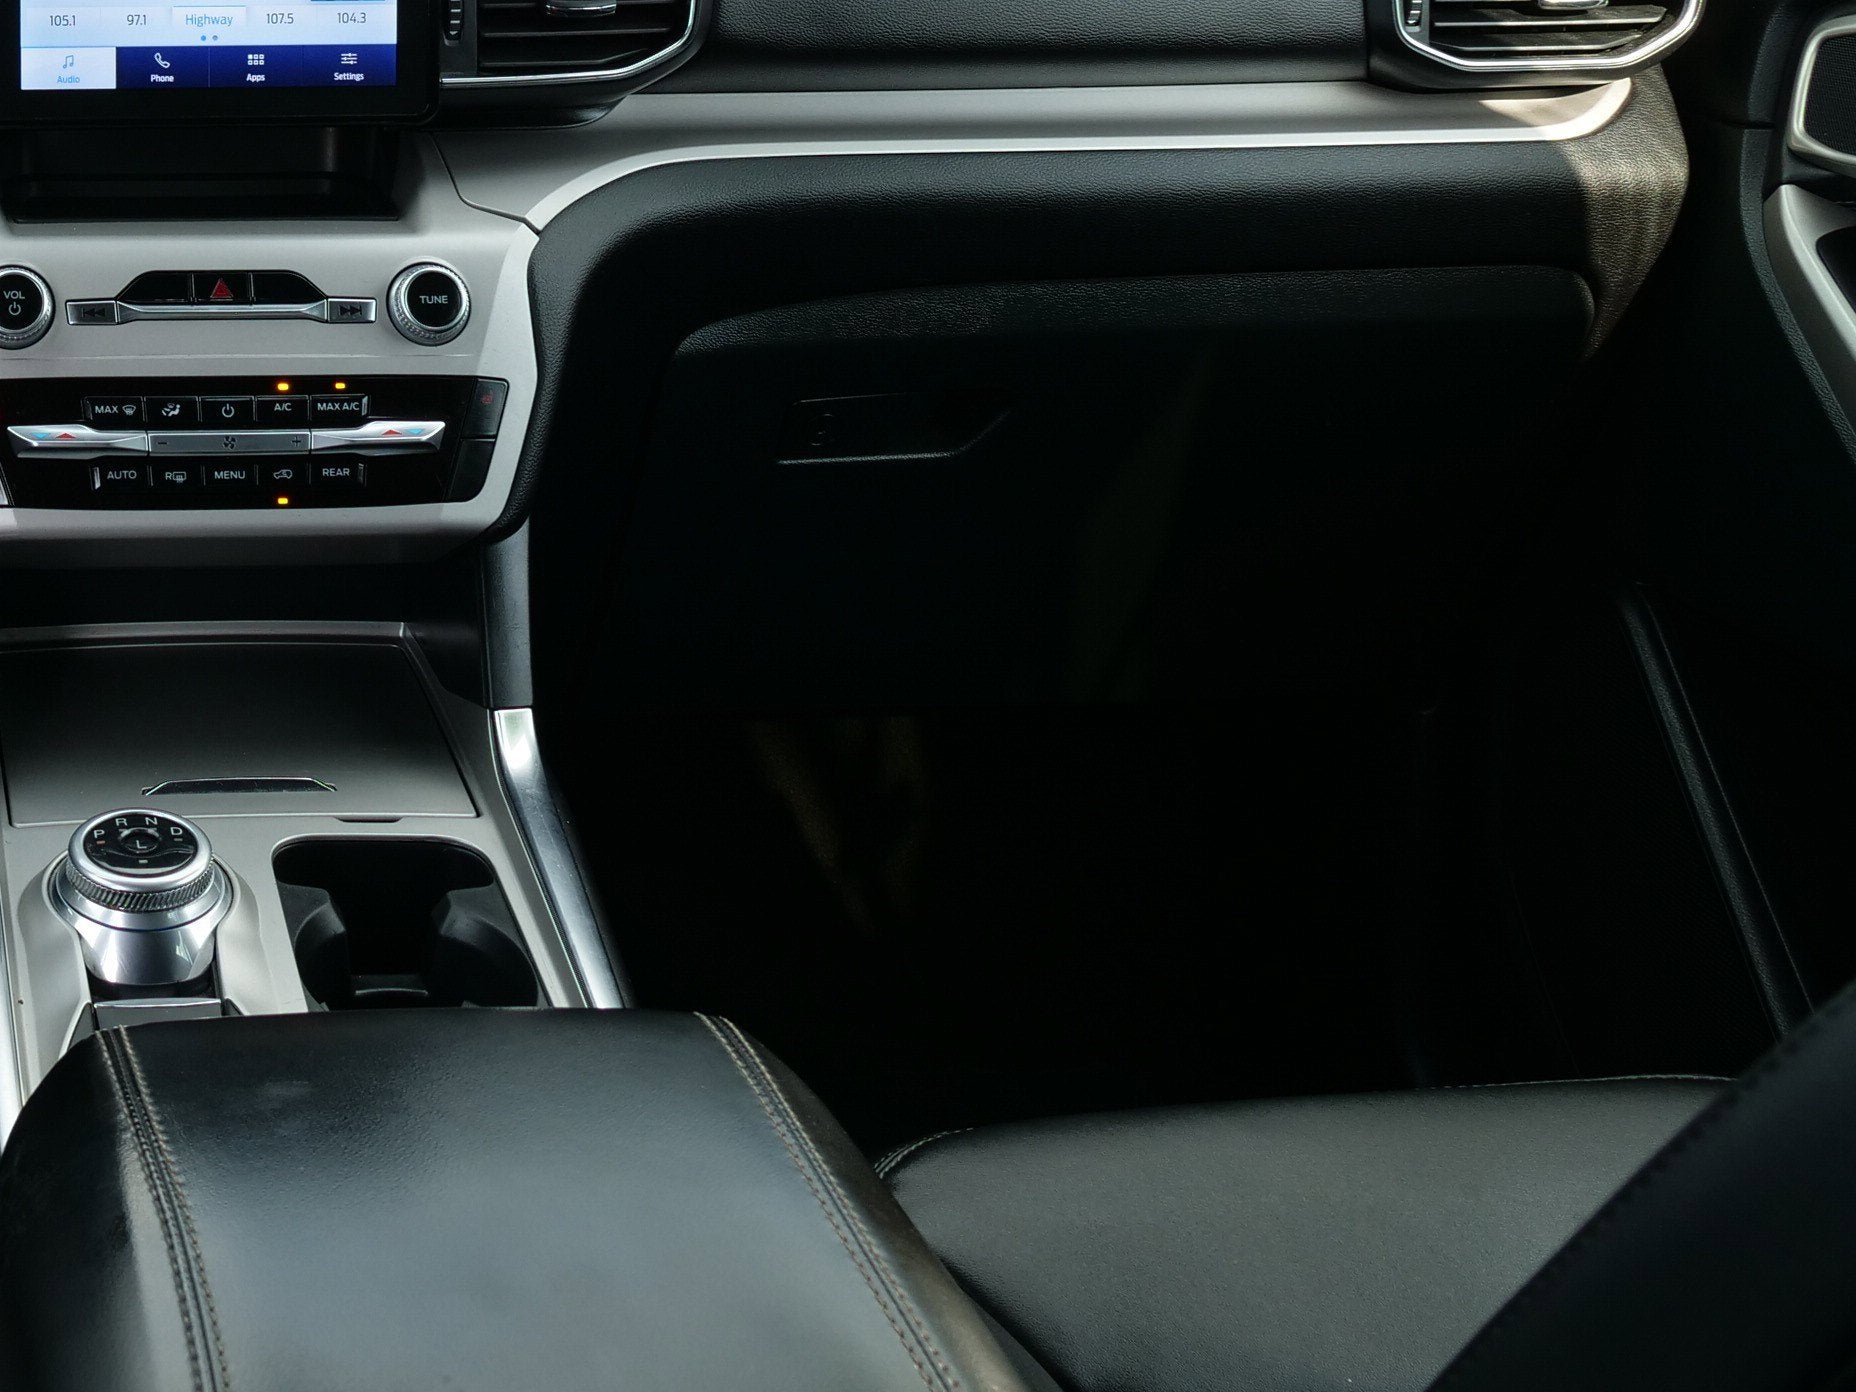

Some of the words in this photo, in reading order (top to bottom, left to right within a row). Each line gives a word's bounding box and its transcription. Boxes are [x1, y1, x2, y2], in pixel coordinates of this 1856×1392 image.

[50, 14, 77, 26] 105.1
[126, 14, 148, 26] 97.1
[185, 13, 233, 28] Highway
[266, 13, 294, 25] 107.5
[337, 12, 367, 24] 104.3
[56, 74, 81, 84] Audio
[150, 73, 175, 83] Phone
[246, 73, 266, 83] Apps
[334, 71, 365, 82] Settings
[2, 290, 25, 300] VOL
[419, 295, 449, 304] TUNE
[94, 405, 119, 414] MAX
[273, 402, 292, 412] A/C
[316, 402, 342, 411] MAX
[342, 401, 361, 411] A/C
[106, 470, 137, 480] AUTO
[213, 469, 246, 479] MENU
[322, 467, 351, 477] REAR
[115, 817, 127, 826] R
[145, 816, 158, 825] N
[93, 829, 105, 839] P
[170, 826, 183, 836] D
[136, 839, 147, 849] L
